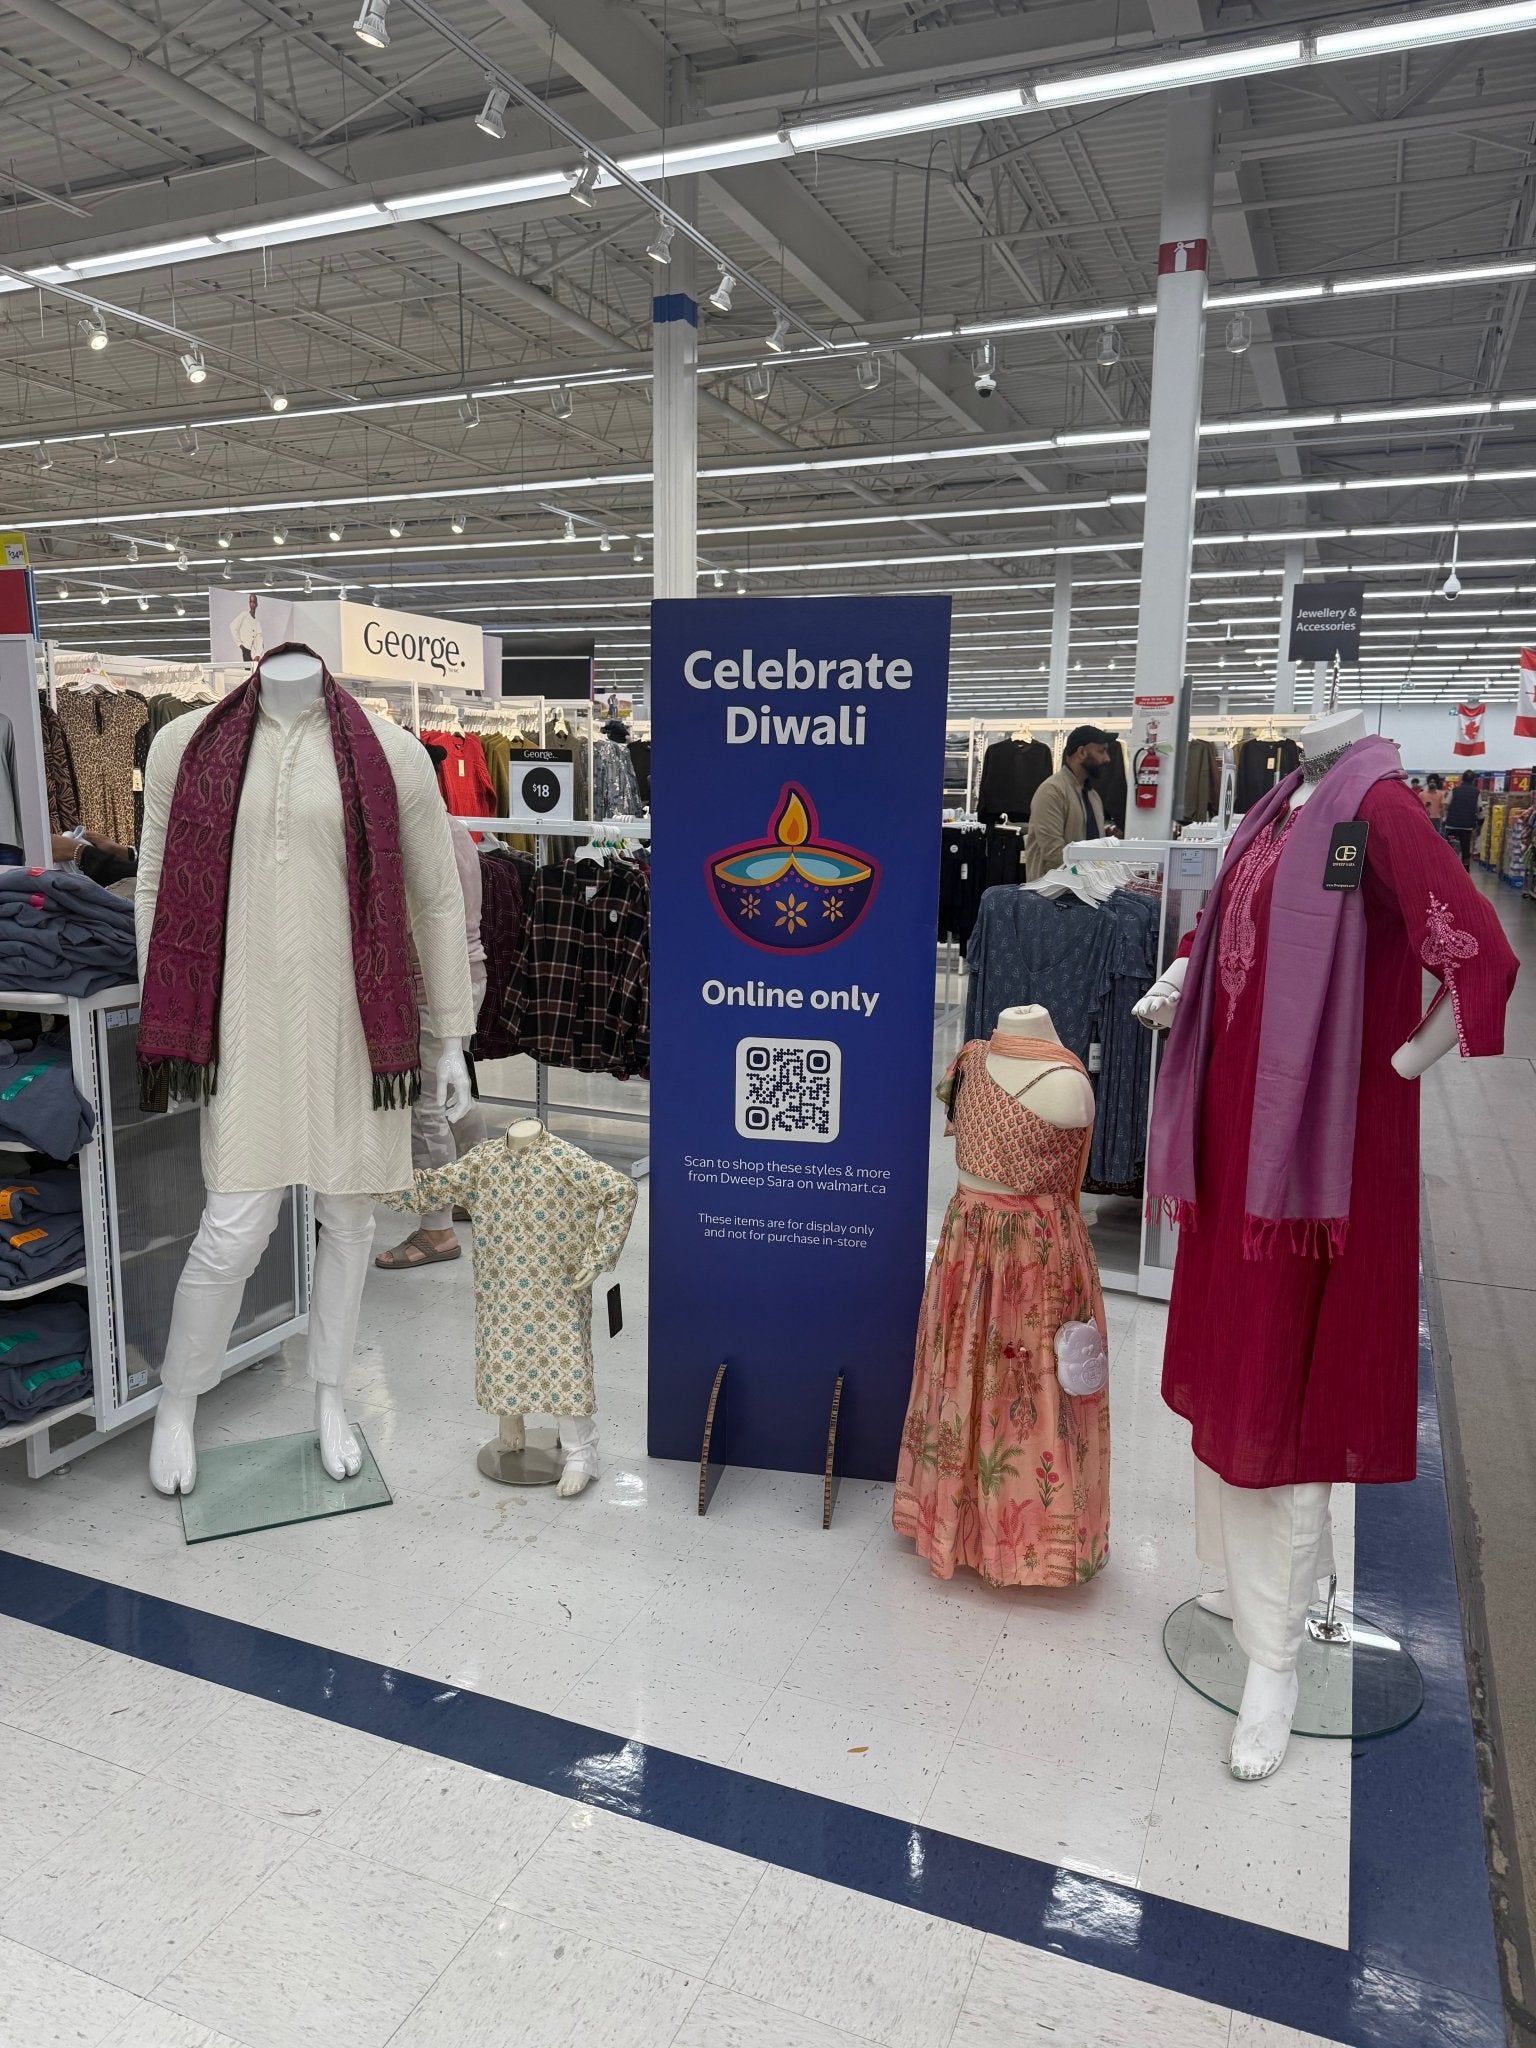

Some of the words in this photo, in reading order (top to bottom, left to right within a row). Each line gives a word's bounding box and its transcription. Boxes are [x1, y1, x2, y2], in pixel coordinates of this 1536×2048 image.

[1297, 608, 1346, 619] Jewellery
[1348, 607, 1357, 616] &
[1296, 622, 1356, 631] Accessories
[364, 621, 466, 677] George.
[683, 648, 913, 690] Celebrate
[726, 704, 867, 746] Diwali
[524, 750, 555, 760] George.
[532, 784, 550, 798] $18
[702, 980, 804, 1009] Online
[810, 984, 880, 1017] only
[684, 1156, 714, 1168] Scan
[717, 1158, 730, 1169] to
[732, 1158, 764, 1172] shop
[767, 1161, 802, 1174] these
[805, 1164, 842, 1177] styles
[844, 1166, 854, 1177] &
[856, 1169, 891, 1179] more
[688, 1170, 717, 1183] from
[721, 1173, 764, 1188] Dweep
[767, 1176, 794, 1188] Sara
[797, 1180, 814, 1190] on
[816, 1179, 886, 1194] walmart.ca
[698, 1213, 732, 1224] These
[734, 1215, 764, 1227] items
[767, 1220, 784, 1229] are
[787, 1219, 803, 1230] for
[806, 1221, 847, 1234] display
[850, 1224, 874, 1236] only
[704, 1228, 725, 1238] and
[728, 1230, 746, 1240] not
[749, 1230, 766, 1241] for
[768, 1233, 820, 1245] purchase
[822, 1234, 867, 1248] in-store
